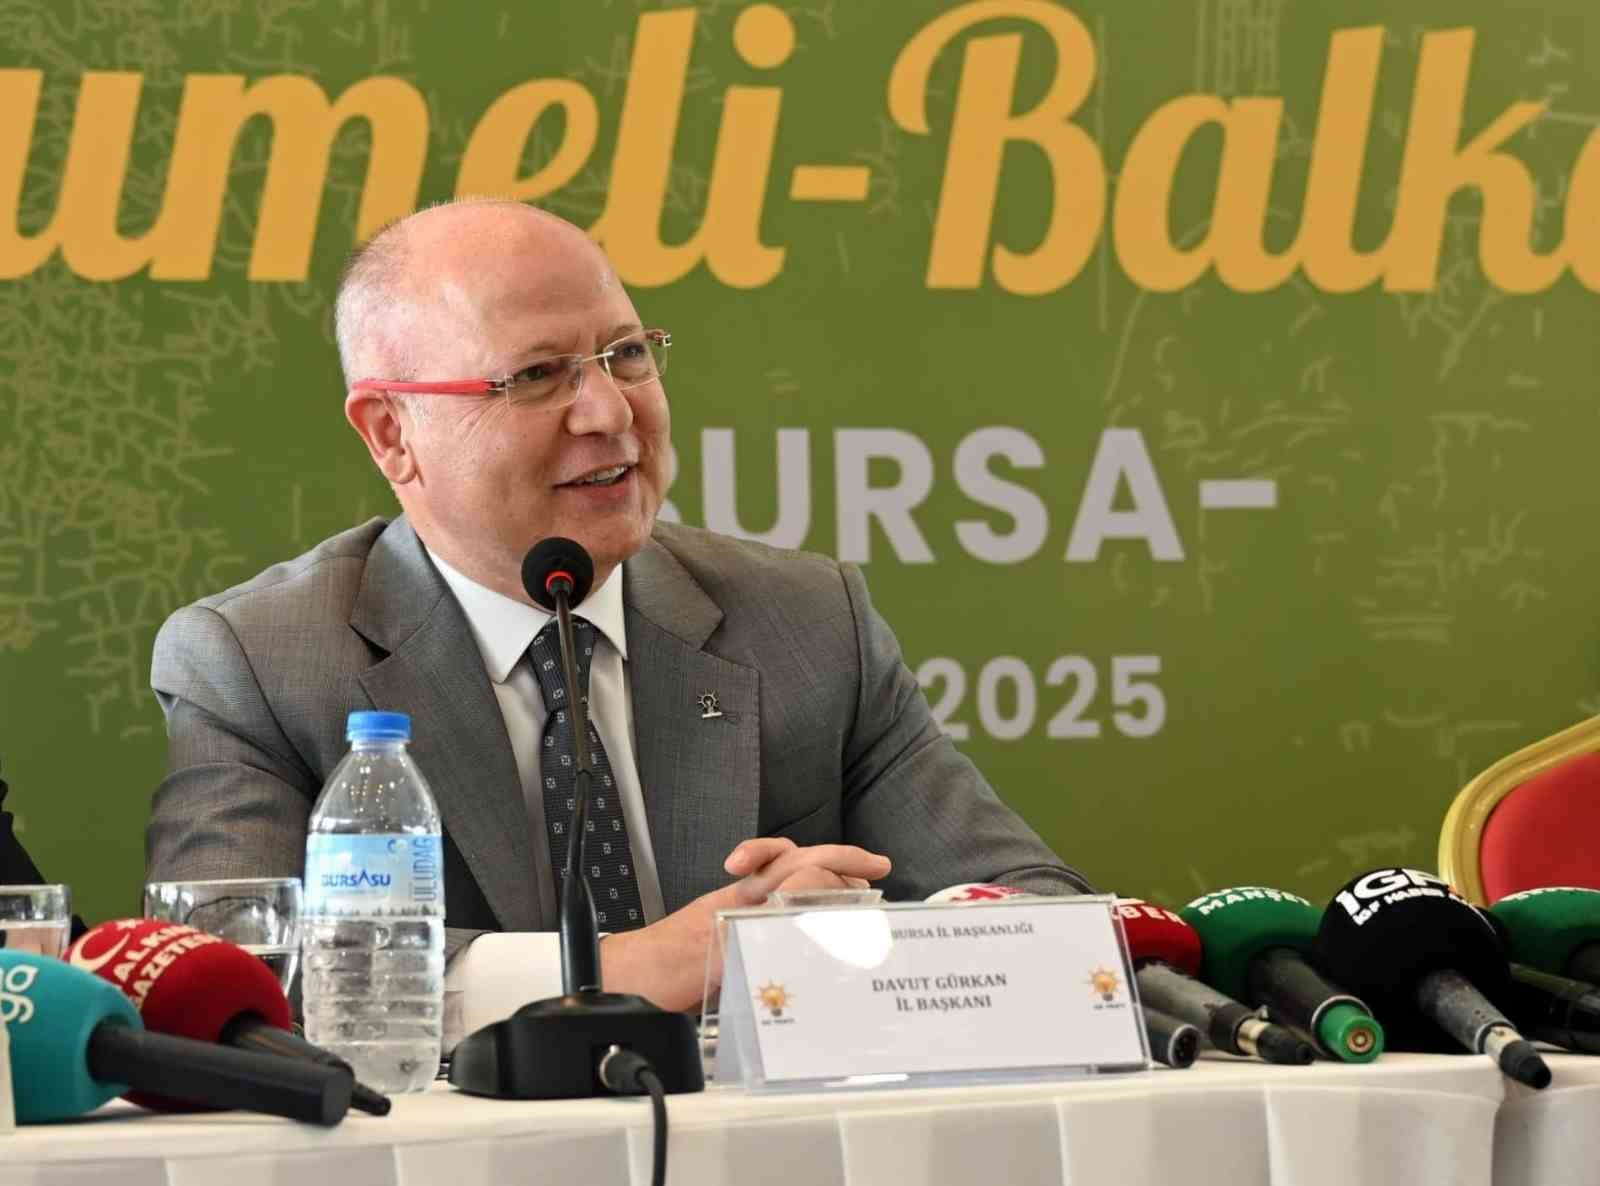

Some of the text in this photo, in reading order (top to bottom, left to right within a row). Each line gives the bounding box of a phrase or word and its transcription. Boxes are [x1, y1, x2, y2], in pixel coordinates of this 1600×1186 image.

[656, 426, 1278, 564] URSA-
[917, 655, 1167, 741] 2025
[871, 972, 1008, 992] DAVUT GÜRKAN
[896, 994, 992, 1012] İL BAŞKANI
